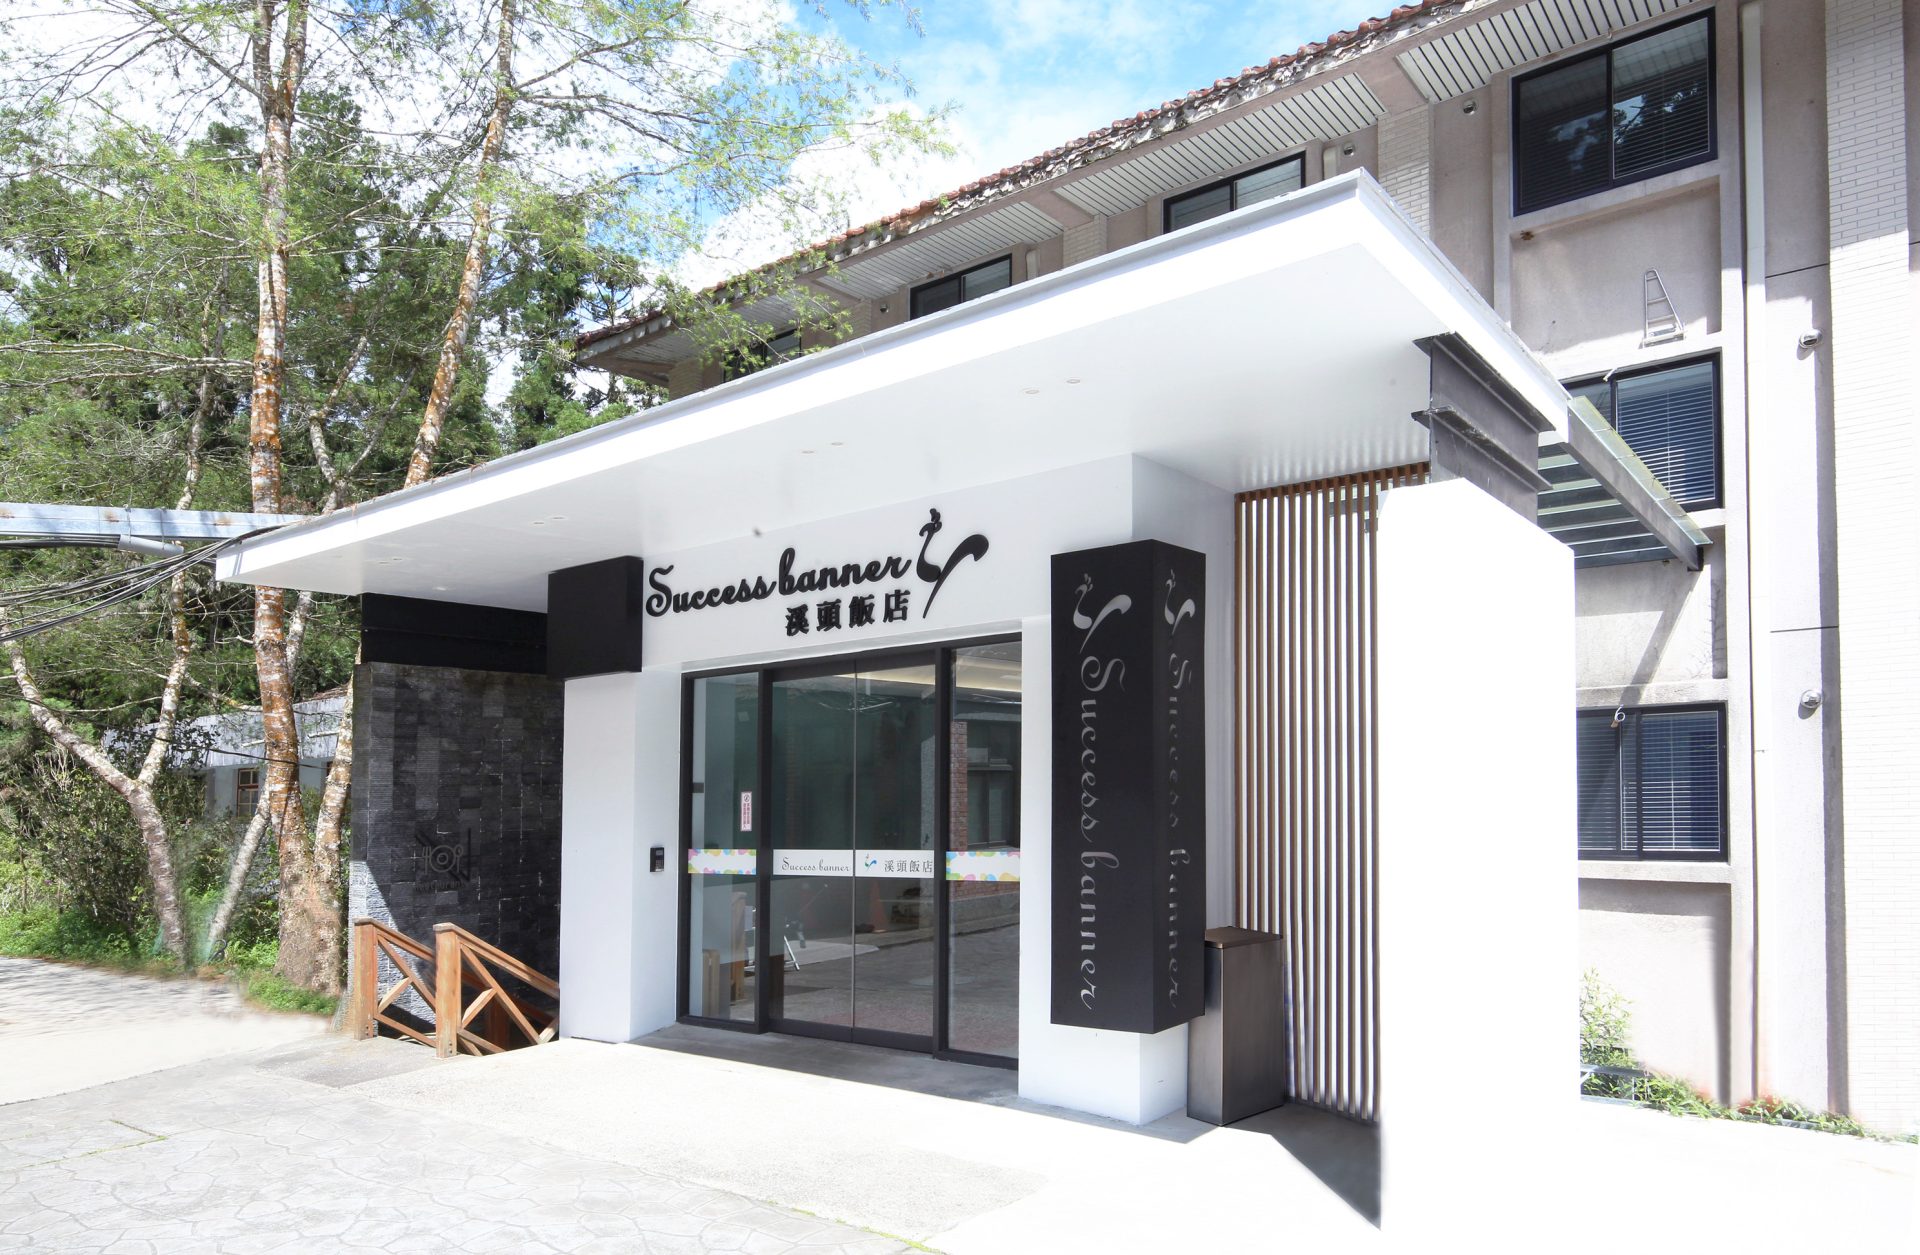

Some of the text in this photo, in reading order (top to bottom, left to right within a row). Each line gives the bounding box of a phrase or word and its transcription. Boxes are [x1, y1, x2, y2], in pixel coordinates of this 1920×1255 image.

[646, 548, 912, 617] Success banner
[785, 589, 911, 637] 溪頭飯店
[1080, 655, 1126, 1010] Success banner
[781, 857, 850, 872] Success banner
[884, 860, 934, 873] 溪頭飯店
